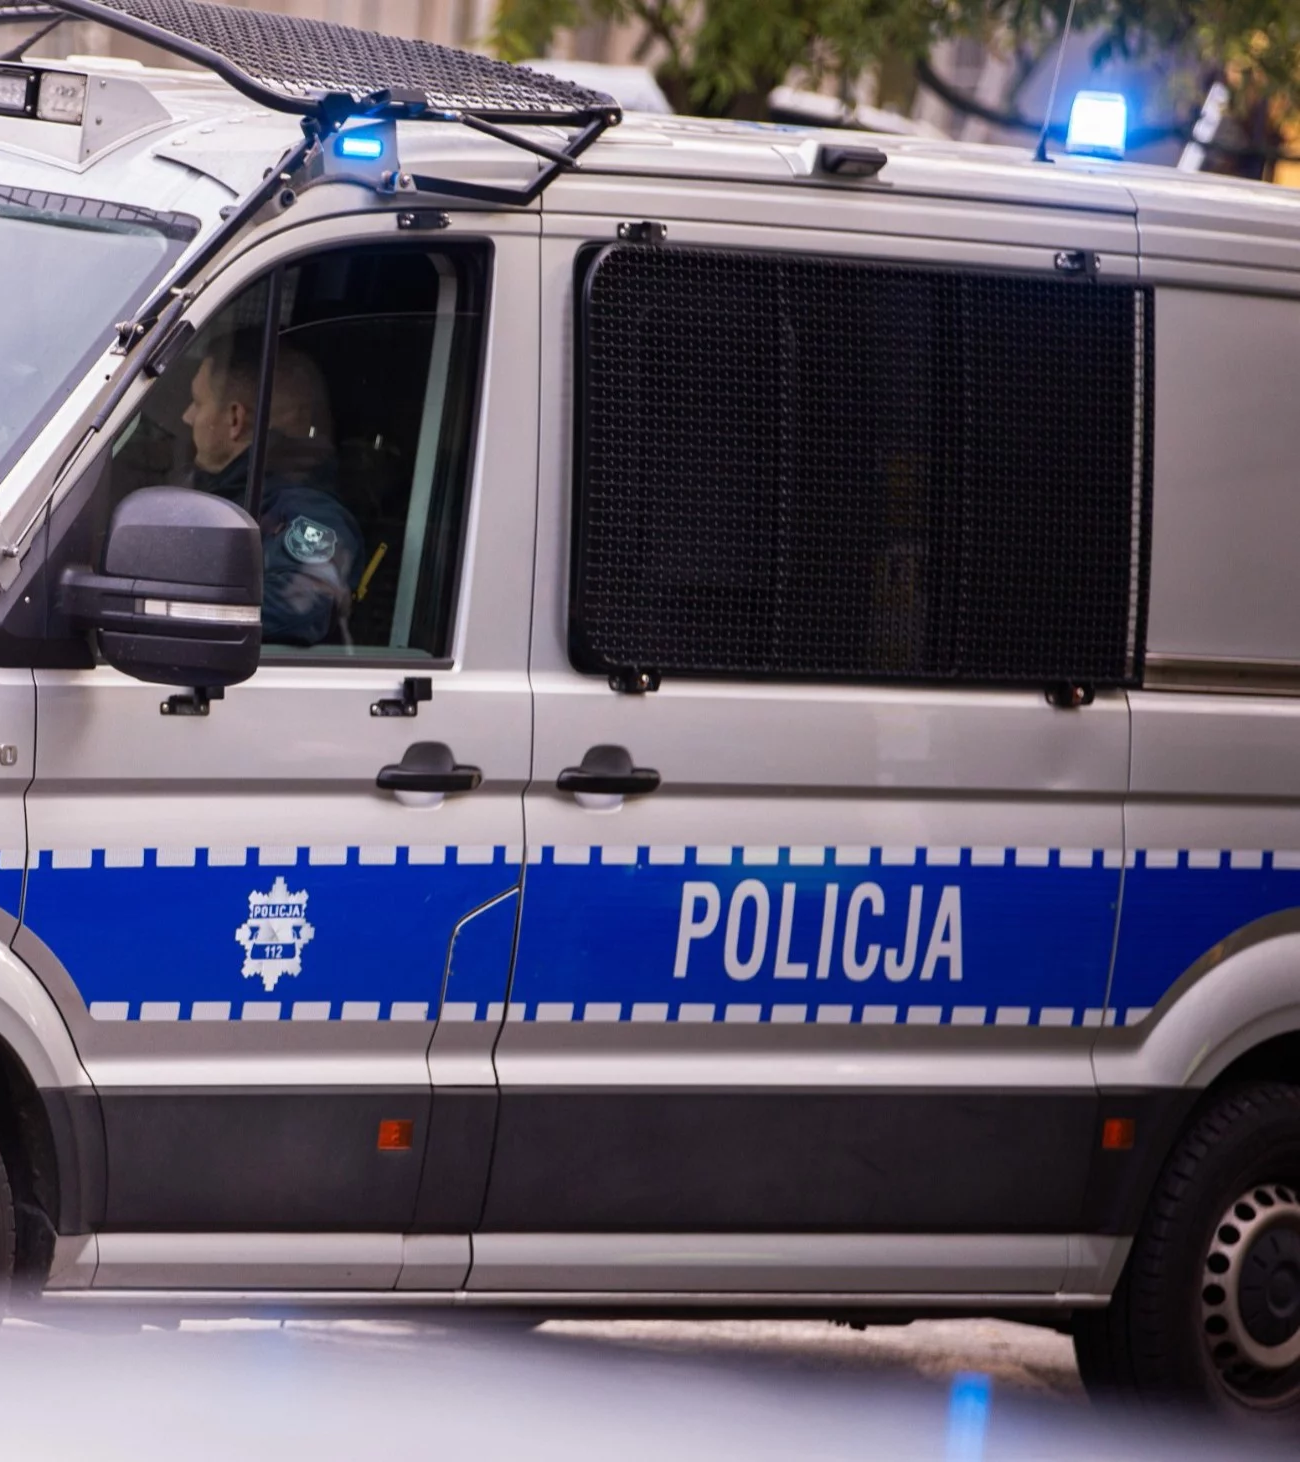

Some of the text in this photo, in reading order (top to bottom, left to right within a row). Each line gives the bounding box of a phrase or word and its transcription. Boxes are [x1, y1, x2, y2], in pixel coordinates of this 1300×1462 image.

[254, 905, 301, 917] POLICJA
[673, 878, 963, 982] POLICJA
[264, 945, 283, 958] 112
